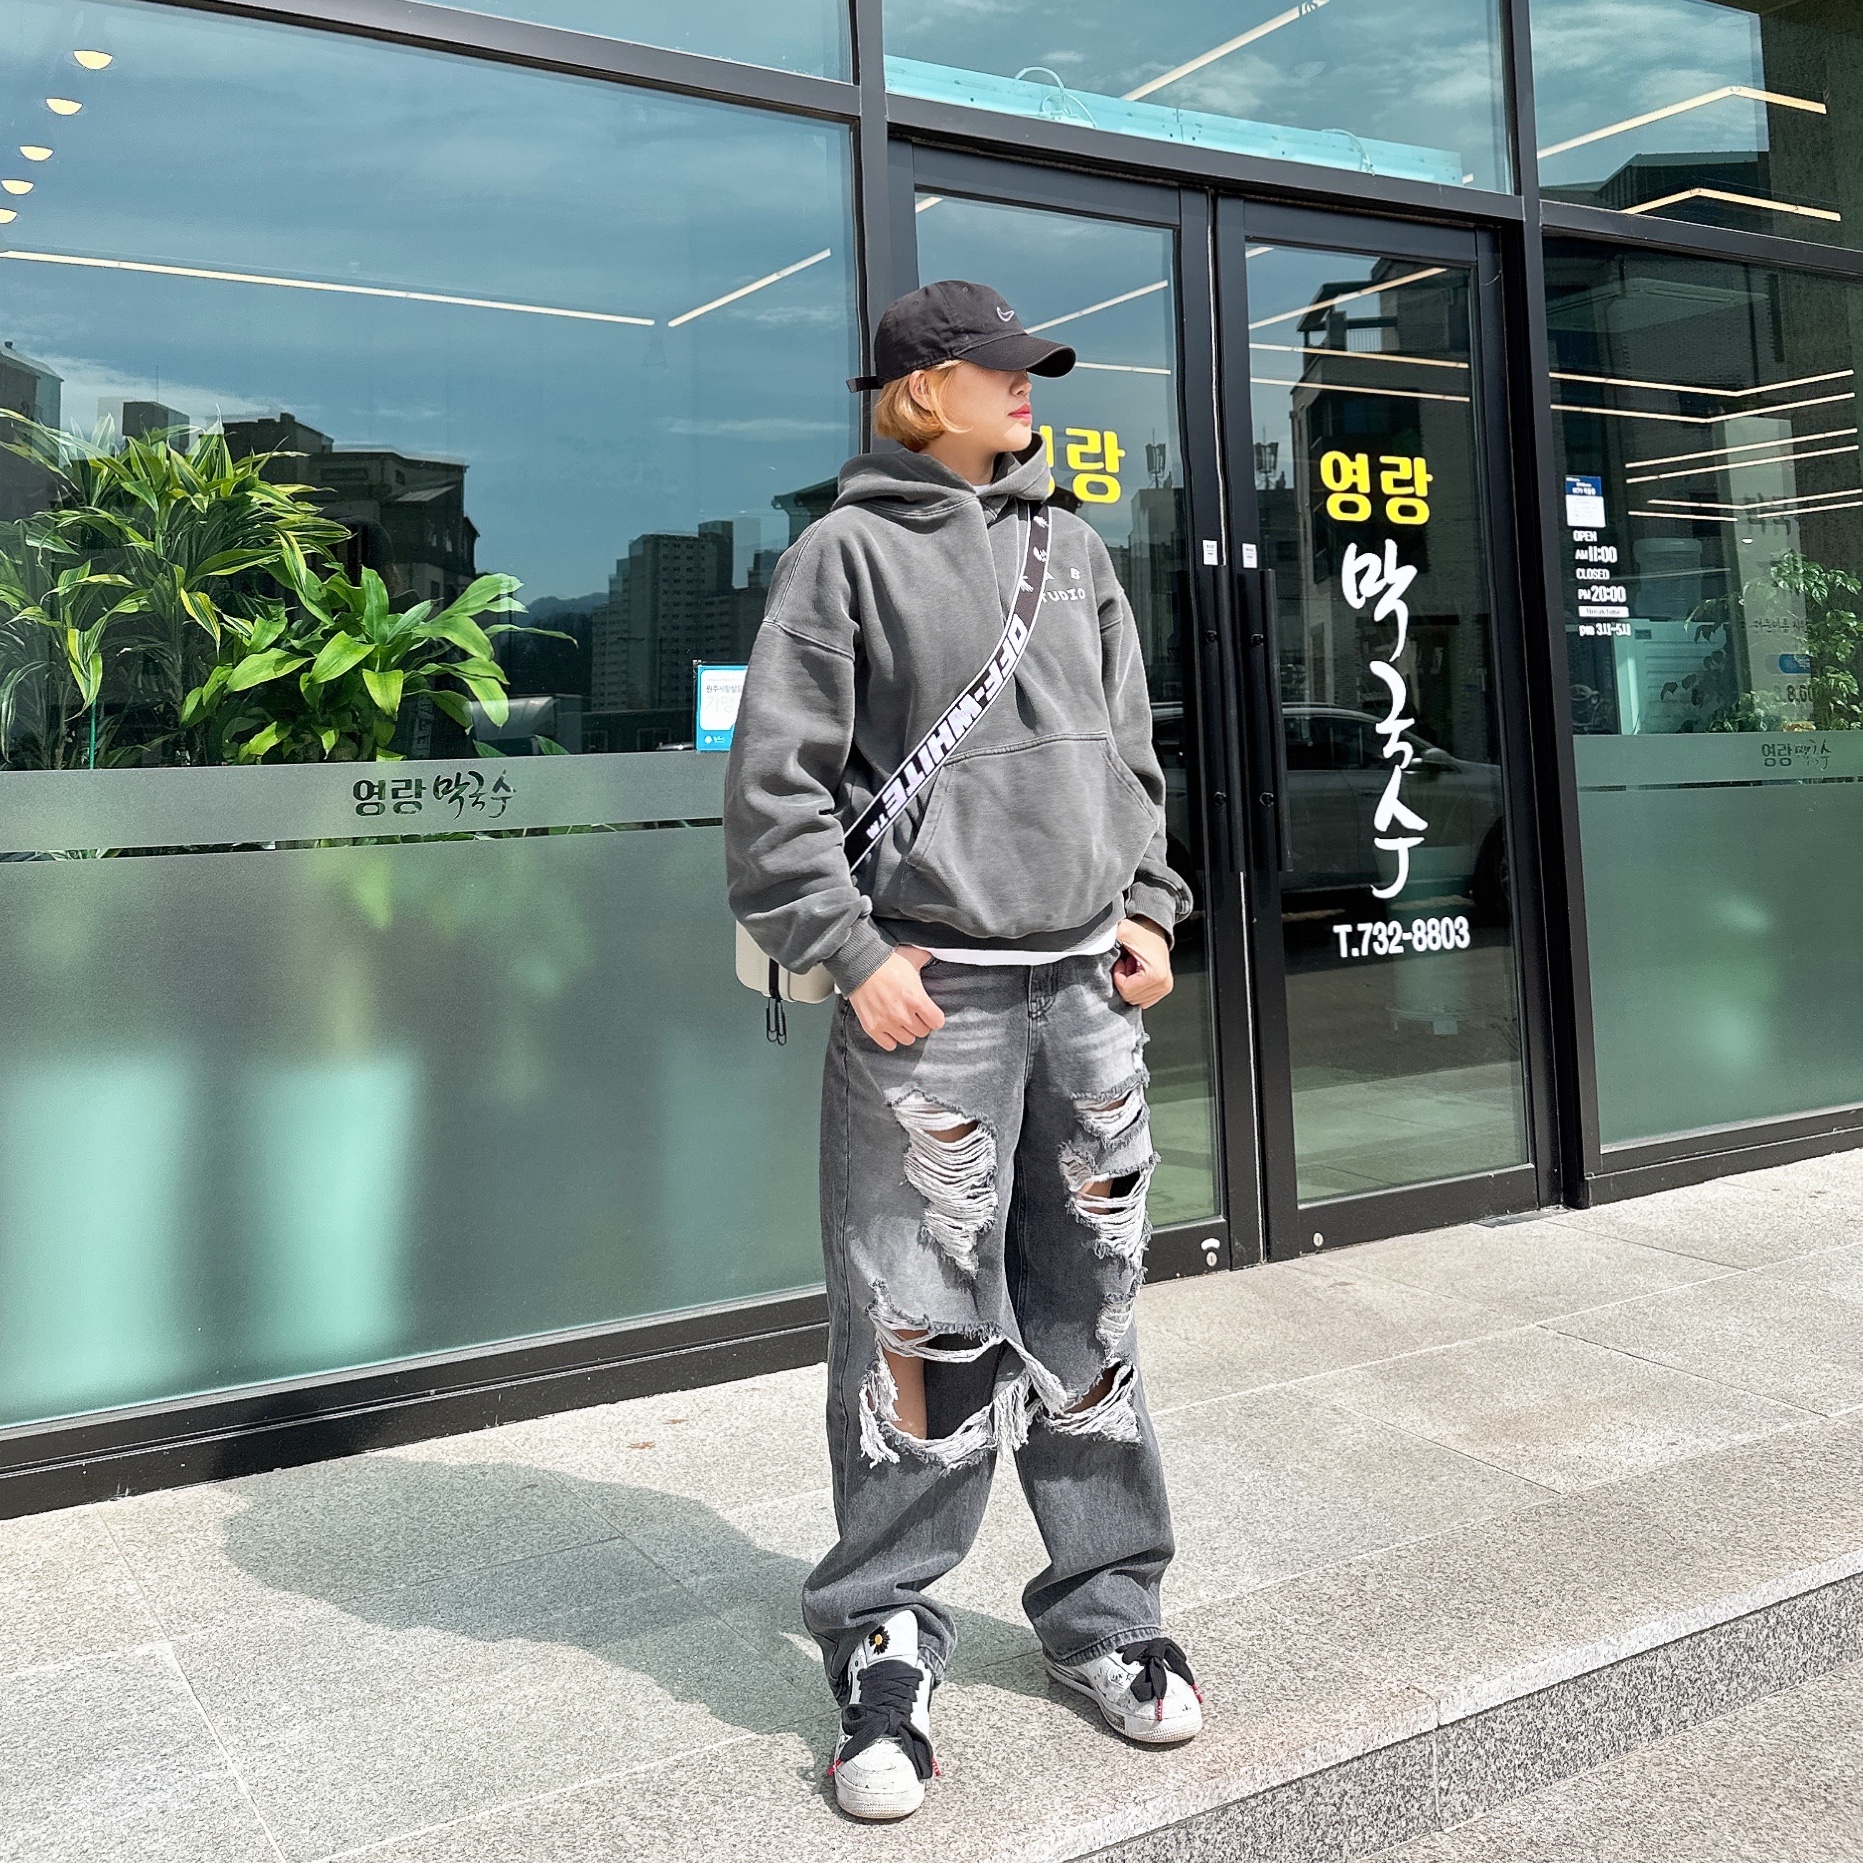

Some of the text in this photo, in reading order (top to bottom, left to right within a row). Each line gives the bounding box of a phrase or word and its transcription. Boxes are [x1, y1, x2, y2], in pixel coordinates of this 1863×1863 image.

[1039, 425, 1126, 504] 랑
[1320, 450, 1433, 525] 영랑
[1573, 530, 1597, 541] OPEN
[1576, 568, 1610, 580] CLOSED
[1761, 743, 1792, 767] 영랑
[352, 769, 517, 819] 영랑 막국수
[1333, 915, 1471, 958] T.732-8803
